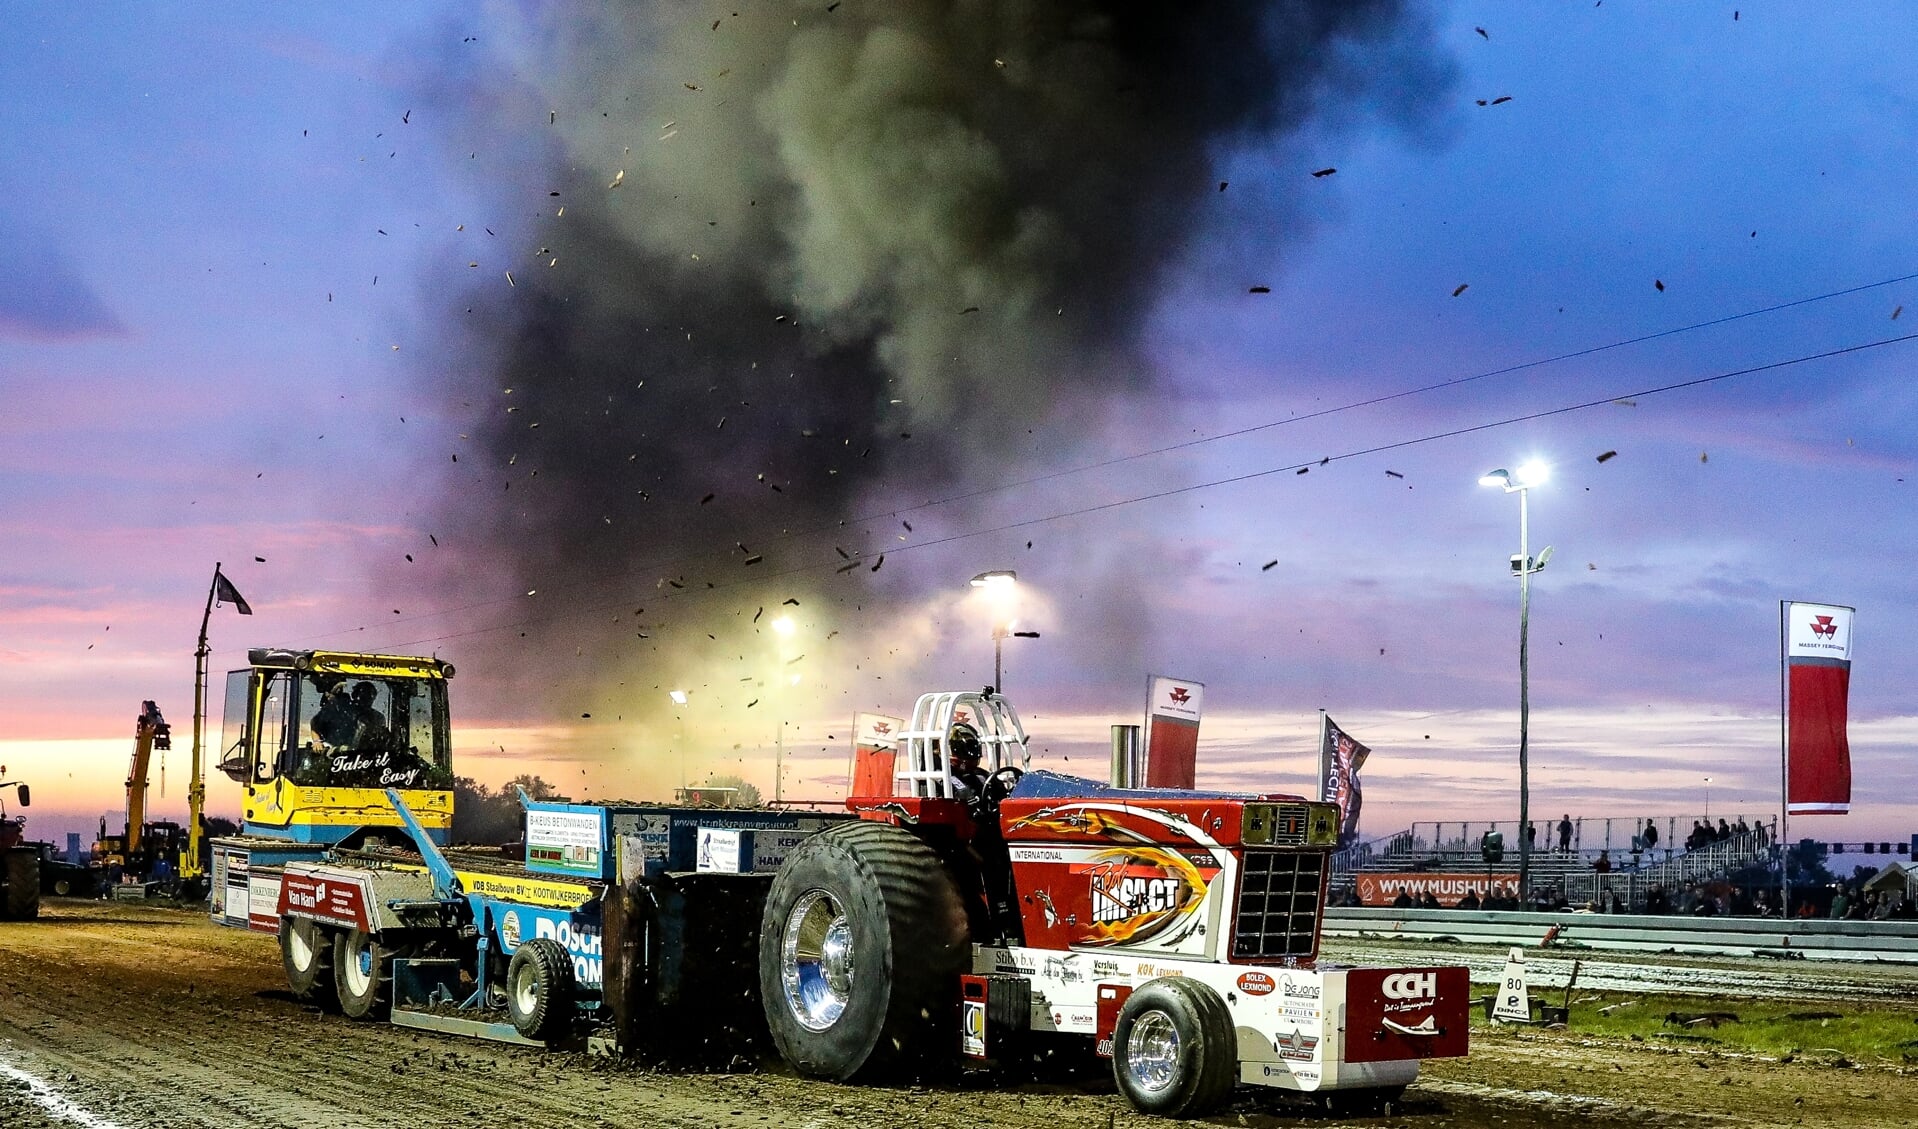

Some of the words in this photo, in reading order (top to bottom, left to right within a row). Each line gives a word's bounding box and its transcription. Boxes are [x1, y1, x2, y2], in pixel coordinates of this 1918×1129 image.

[331, 754, 373, 773] Take
[375, 751, 391, 767] it
[380, 767, 420, 786] Easy
[530, 815, 551, 827] B-KEUS
[552, 816, 598, 830] BETONWANDEN
[1014, 850, 1063, 861] INTERNATIONAL
[473, 880, 485, 891] VDB
[486, 881, 515, 895] Staalbouw
[516, 885, 524, 896] BV
[288, 889, 300, 906] Van
[300, 892, 316, 909] Ham
[1092, 876, 1179, 922] IMPACT
[995, 950, 1019, 965] Stibo
[1137, 963, 1155, 977] KOK
[1156, 968, 1184, 977] LEXMOND
[1245, 973, 1266, 983] BOLEX
[1507, 977, 1522, 991] 80
[1240, 982, 1272, 993] LEXMOND
[1382, 972, 1437, 1000] CCH
[1284, 1008, 1313, 1017] PAVIJEN
